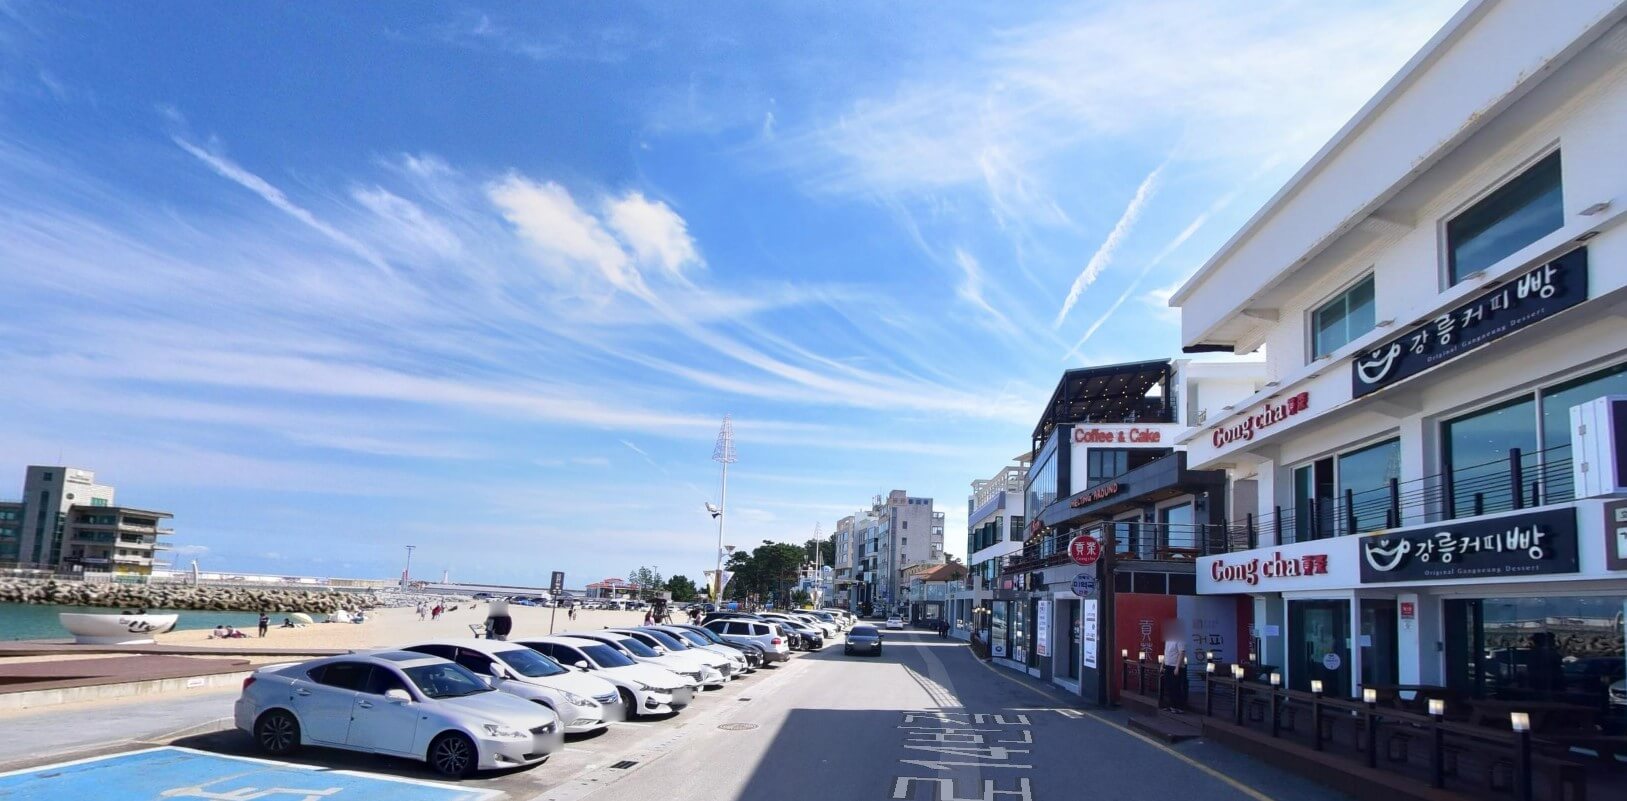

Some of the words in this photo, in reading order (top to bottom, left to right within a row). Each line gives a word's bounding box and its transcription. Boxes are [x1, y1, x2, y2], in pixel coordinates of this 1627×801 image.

[1409, 263, 1558, 354] 강릉커피빵
[1426, 346, 1458, 363] Original
[1510, 307, 1545, 326] Dessert
[1074, 428, 1114, 443] Coffee
[1117, 430, 1126, 443] &
[1129, 427, 1161, 443] Cake
[1211, 416, 1254, 448] Gong
[1254, 404, 1288, 430] cha
[1415, 524, 1545, 563] 강릉커피빵
[1211, 557, 1259, 585] Gong
[1261, 551, 1301, 577] cha
[1424, 568, 1455, 577] Original
[1505, 564, 1540, 573] Dessert
